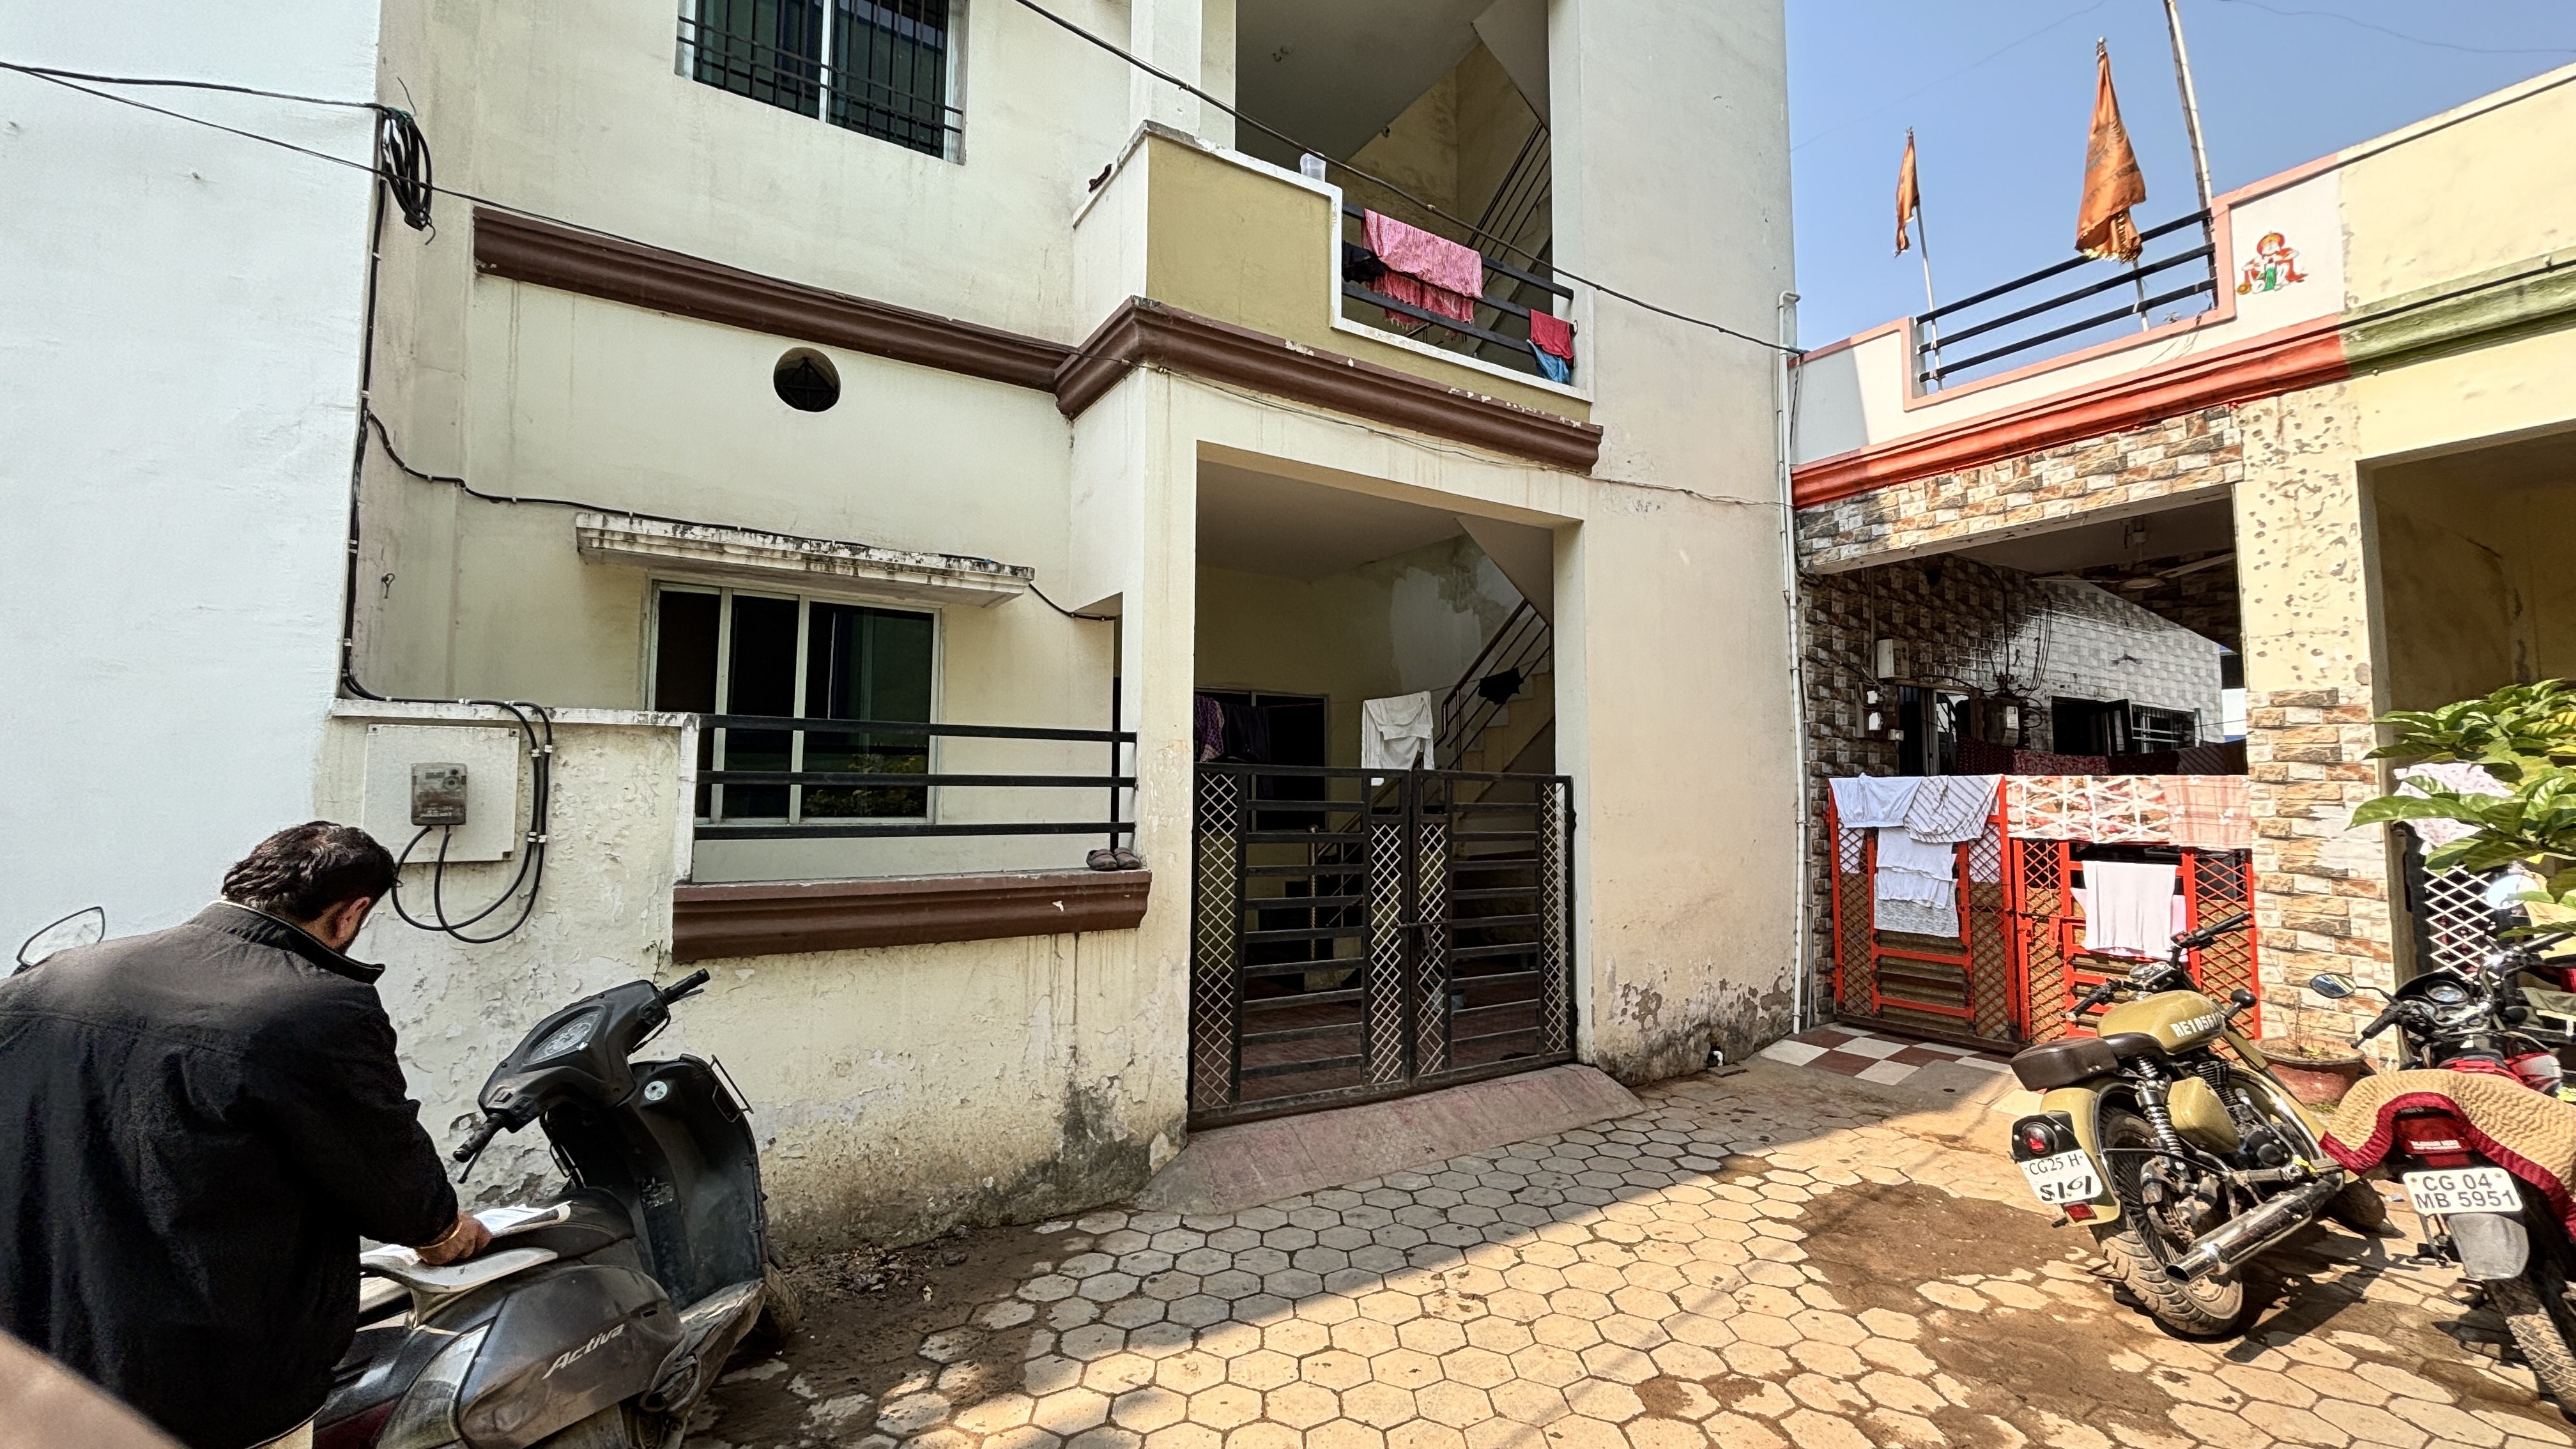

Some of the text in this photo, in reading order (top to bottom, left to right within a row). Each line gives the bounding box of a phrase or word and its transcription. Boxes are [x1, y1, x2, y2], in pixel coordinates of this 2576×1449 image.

[2067, 1153, 2080, 1167] H
[2422, 1173, 2492, 1192] CG 04
[2414, 1190, 2516, 1209] MB 5951
[541, 1323, 625, 1381] Activa
